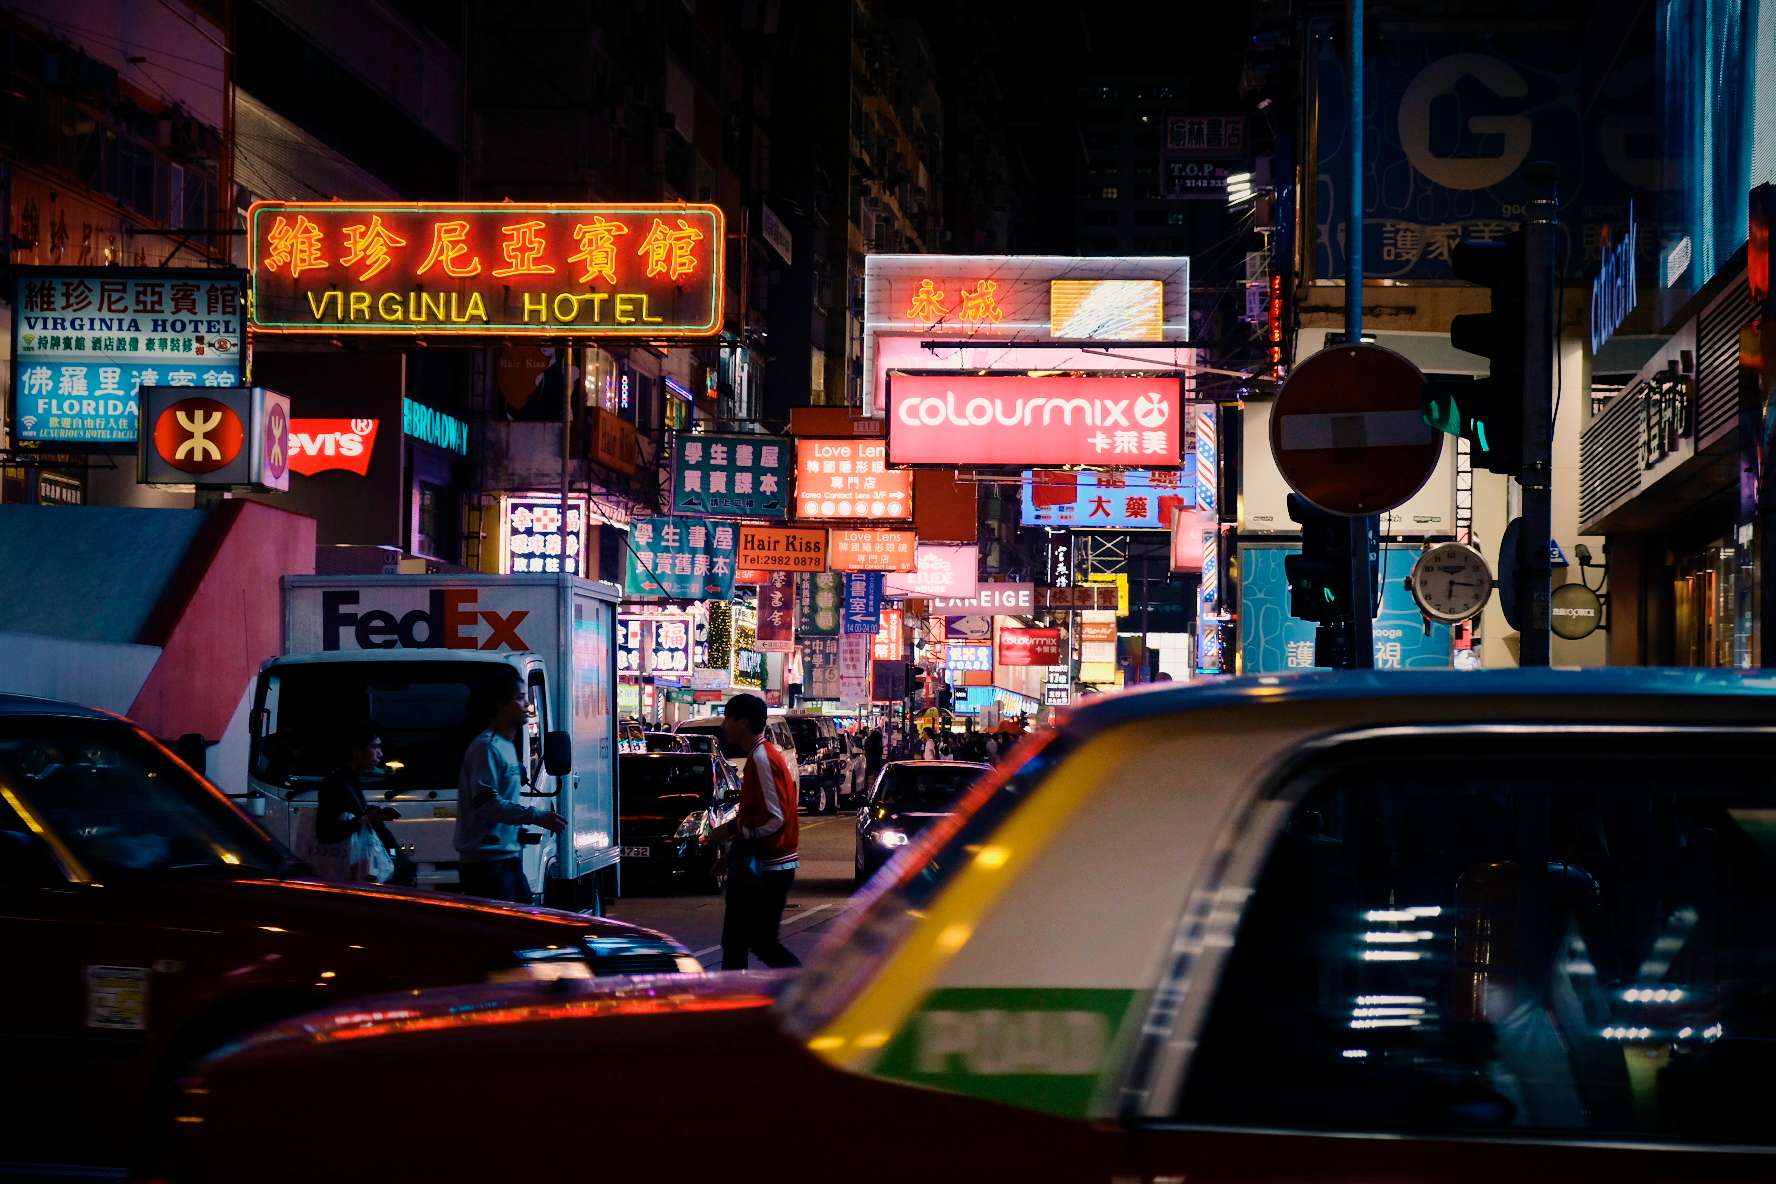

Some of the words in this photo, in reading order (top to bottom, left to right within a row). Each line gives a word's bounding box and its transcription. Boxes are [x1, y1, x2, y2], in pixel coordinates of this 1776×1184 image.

[263, 215, 703, 284] 維珍尼亞賓館
[24, 279, 239, 316] 維珍尼亞賓館
[307, 291, 489, 322] VIRGINIA
[523, 292, 664, 324] HOTEL
[24, 316, 141, 332] VIRGINIA
[152, 318, 237, 334] HOTEL
[38, 399, 138, 416] FLORIDA
[899, 391, 1131, 427] colourmix
[412, 400, 468, 456] BROADWAY
[685, 442, 779, 468] 學生書屋
[815, 444, 850, 458] Love
[859, 444, 886, 458] Len
[1088, 431, 1168, 455] 卡萊美
[635, 523, 733, 549] 學生書屋
[743, 534, 780, 552] Hair
[785, 534, 821, 553] Kiss
[844, 531, 871, 542] Love
[876, 531, 902, 542] Lens
[743, 554, 791, 566] Tel:2982
[794, 555, 821, 567] 0878
[321, 589, 529, 651] FedEx
